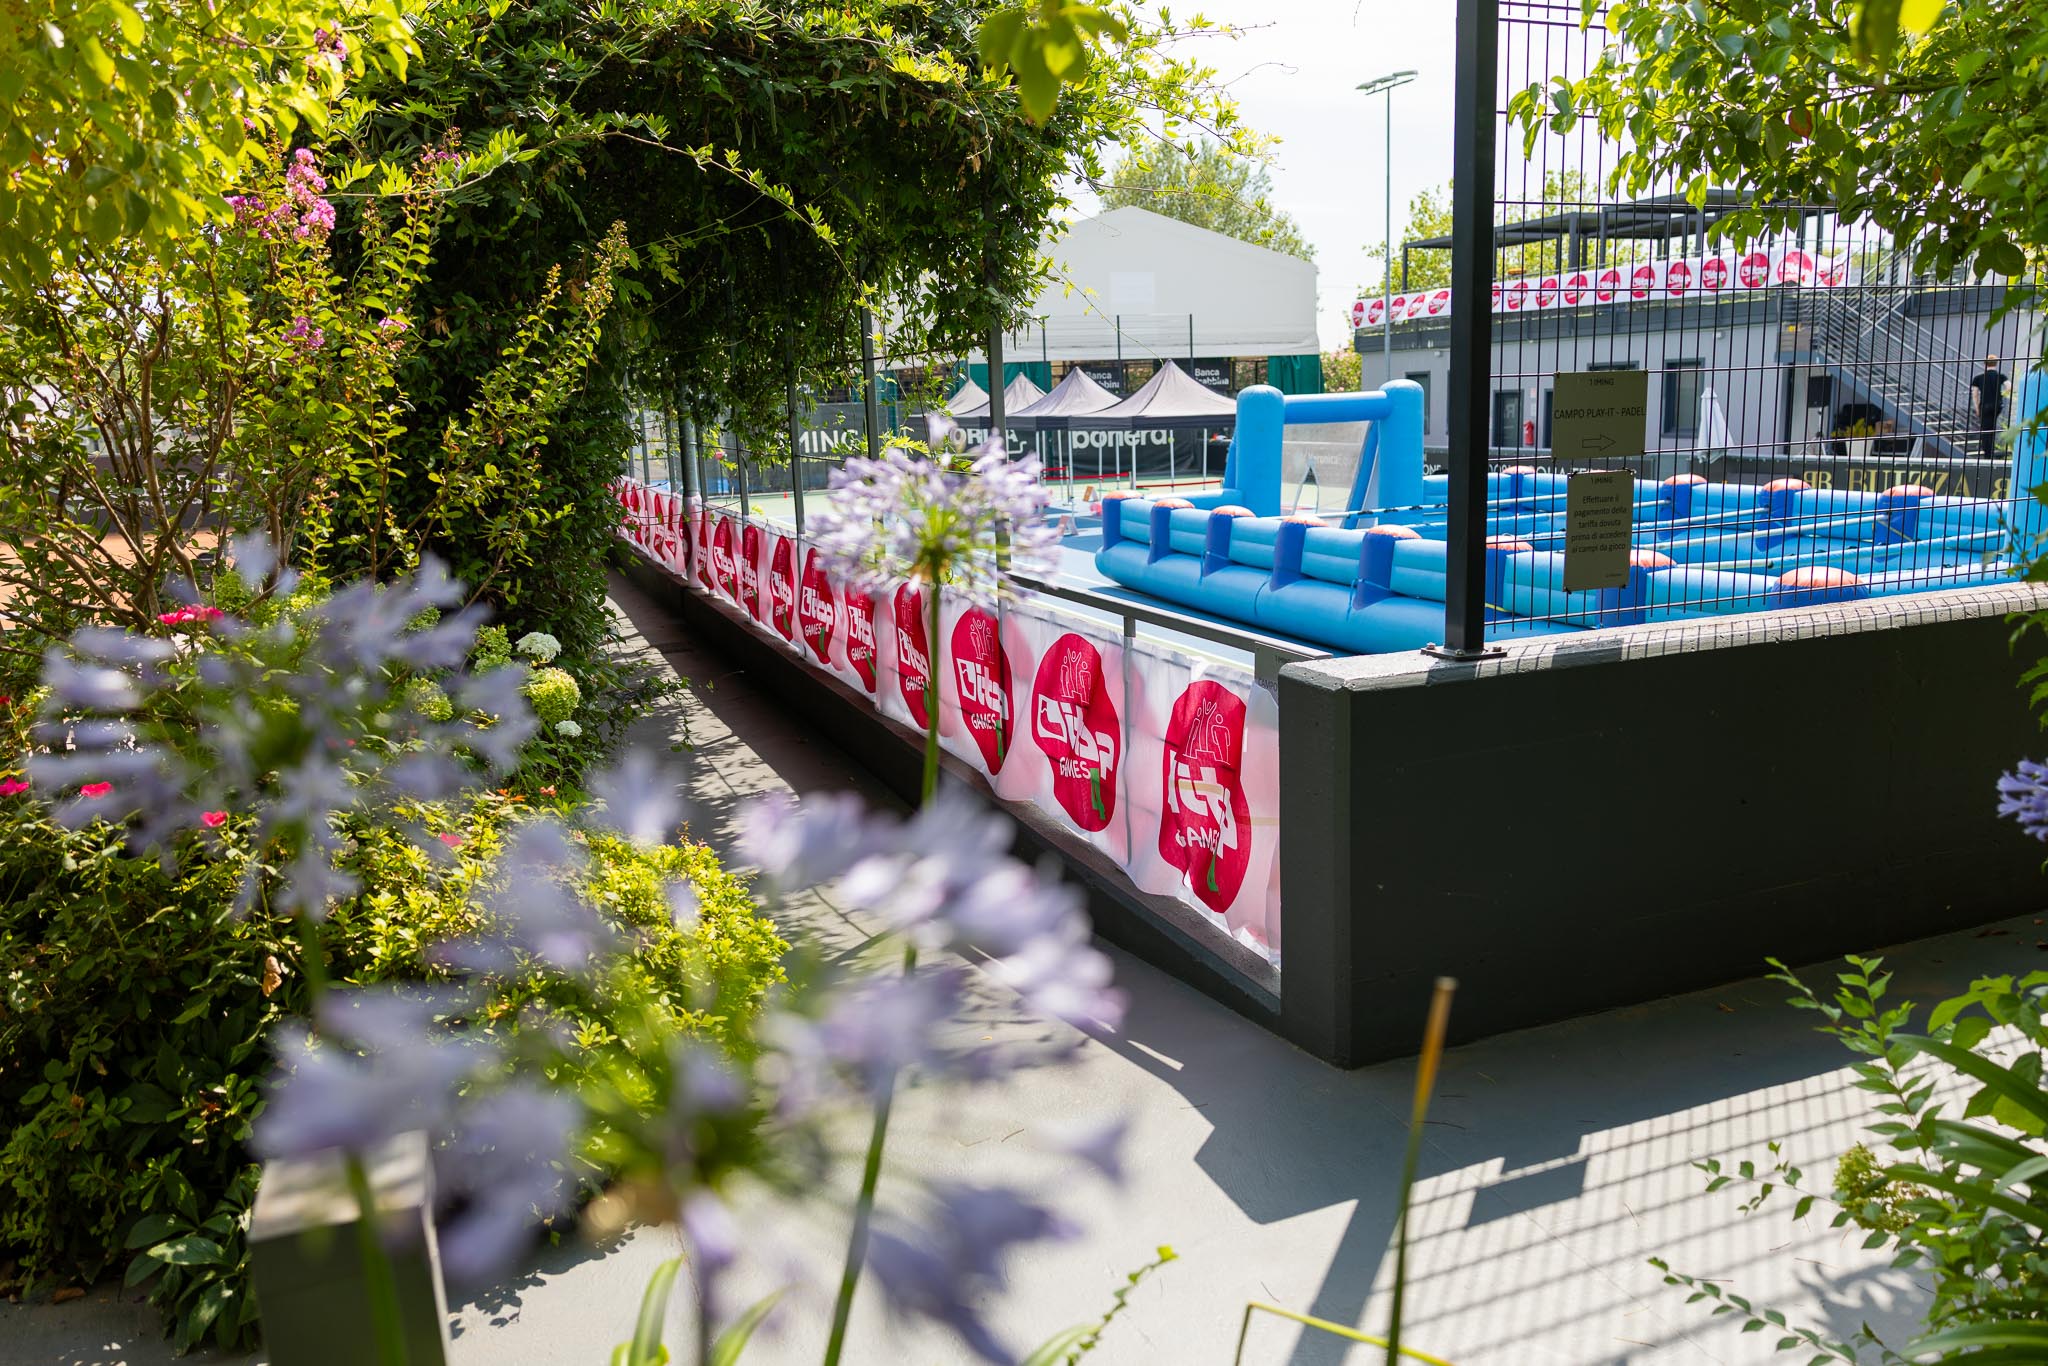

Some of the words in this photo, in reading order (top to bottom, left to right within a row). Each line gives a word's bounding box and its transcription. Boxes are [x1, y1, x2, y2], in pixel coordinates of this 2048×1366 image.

[1194, 368, 1220, 377] Banca
[1554, 408, 1585, 420] CAMPO
[1586, 407, 1616, 418] PLAY-IT
[1621, 406, 1647, 417] PADEL
[1582, 495, 1614, 504] Effettuare
[1573, 508, 1610, 519] pagamento
[1610, 506, 1627, 515] della
[1578, 519, 1598, 529] tariffa
[1599, 518, 1621, 528] dovuta
[1570, 532, 1591, 544] prima
[1598, 530, 1627, 540] accedere
[1599, 543, 1608, 552] da
[1608, 542, 1626, 553] gioco
